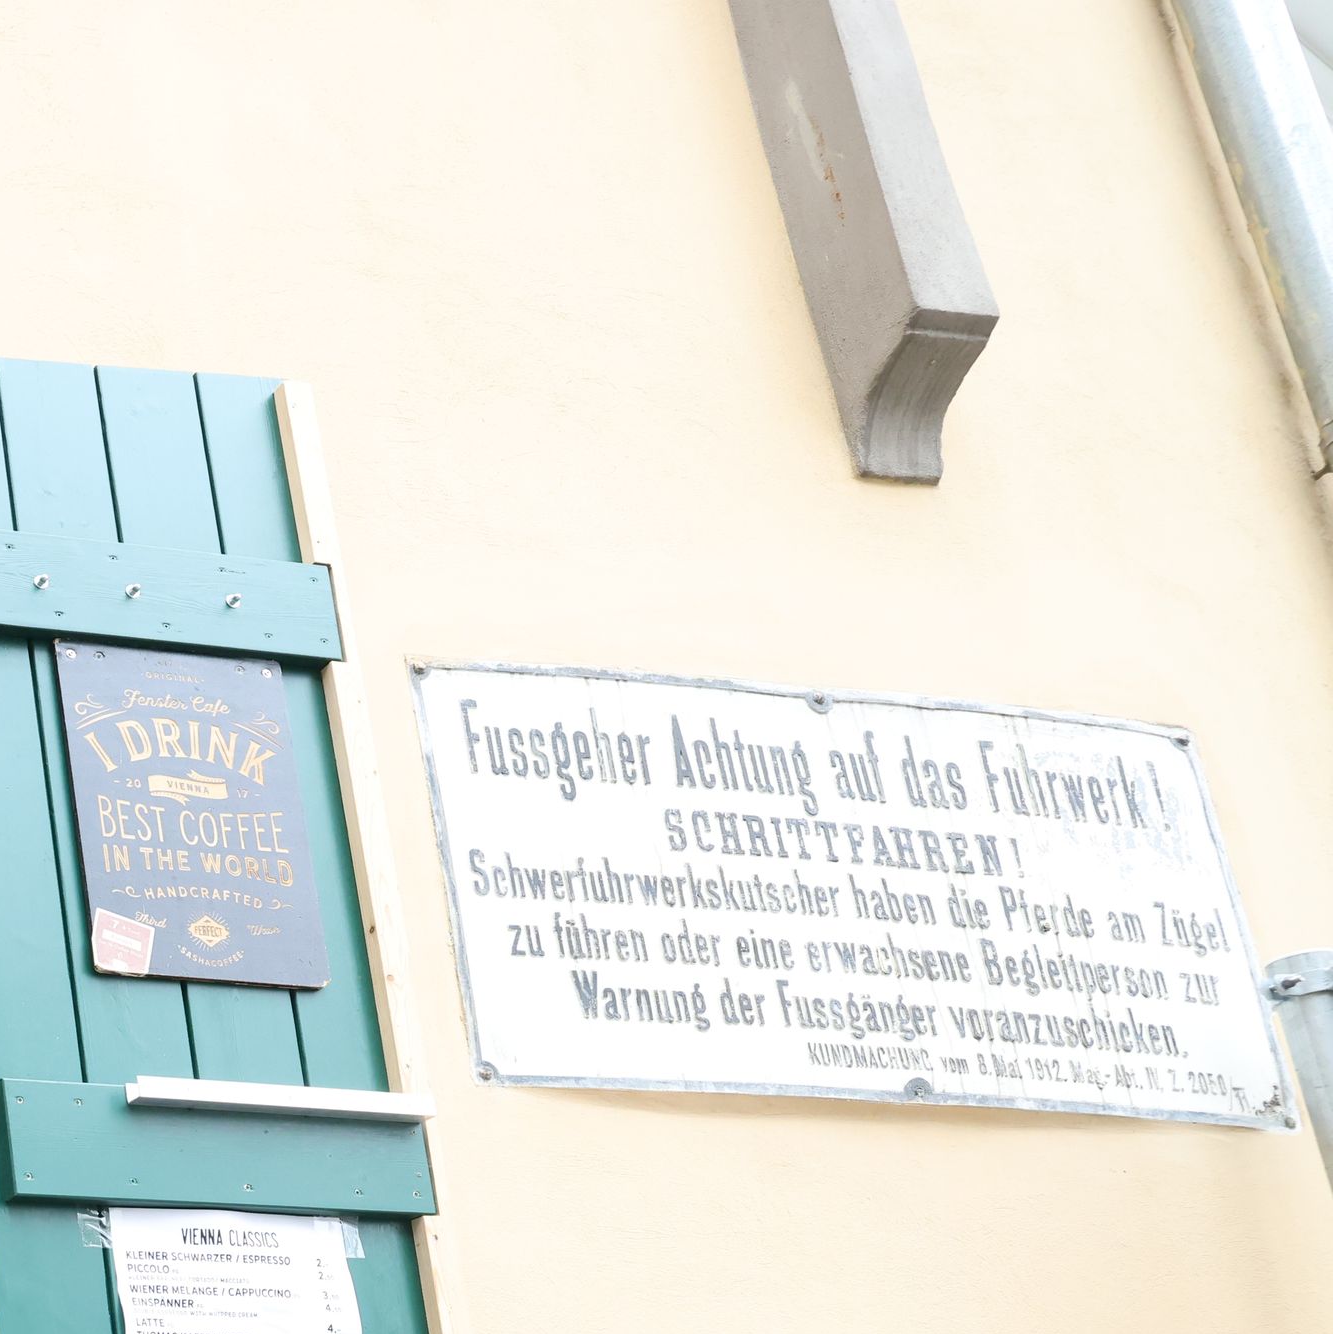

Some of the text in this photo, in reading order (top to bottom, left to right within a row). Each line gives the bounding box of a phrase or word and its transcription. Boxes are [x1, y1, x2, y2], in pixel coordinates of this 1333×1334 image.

[123, 688, 230, 717] Fenster Cafe
[84, 717, 277, 786] I DRINK
[459, 698, 653, 801] Fussgeher
[670, 713, 819, 816] Achtung
[830, 731, 887, 806] auf
[902, 735, 968, 810] das
[166, 779, 211, 795] VIENNA
[97, 794, 290, 854] BEST COFFEE
[102, 844, 295, 887] IN THE WORLD
[144, 886, 263, 910] HANDCRAFTED
[469, 848, 1231, 957] Schwerfuhrwerkskutscher haben die Pferde am Zügel
[507, 911, 1220, 1006] zu führen oder eine erwachsene Begleitperson zur
[571, 970, 1190, 1060] Warnung der Fussgänger voranzuschicken.
[940, 1055, 970, 1075] vom
[181, 1227, 279, 1248] VIENNA CLASSICS
[242, 1254, 291, 1266] ESPRESSO
[171, 1285, 292, 1299] MELANGE CAPPUCCINO
[135, 1317, 165, 1328] LATTE
